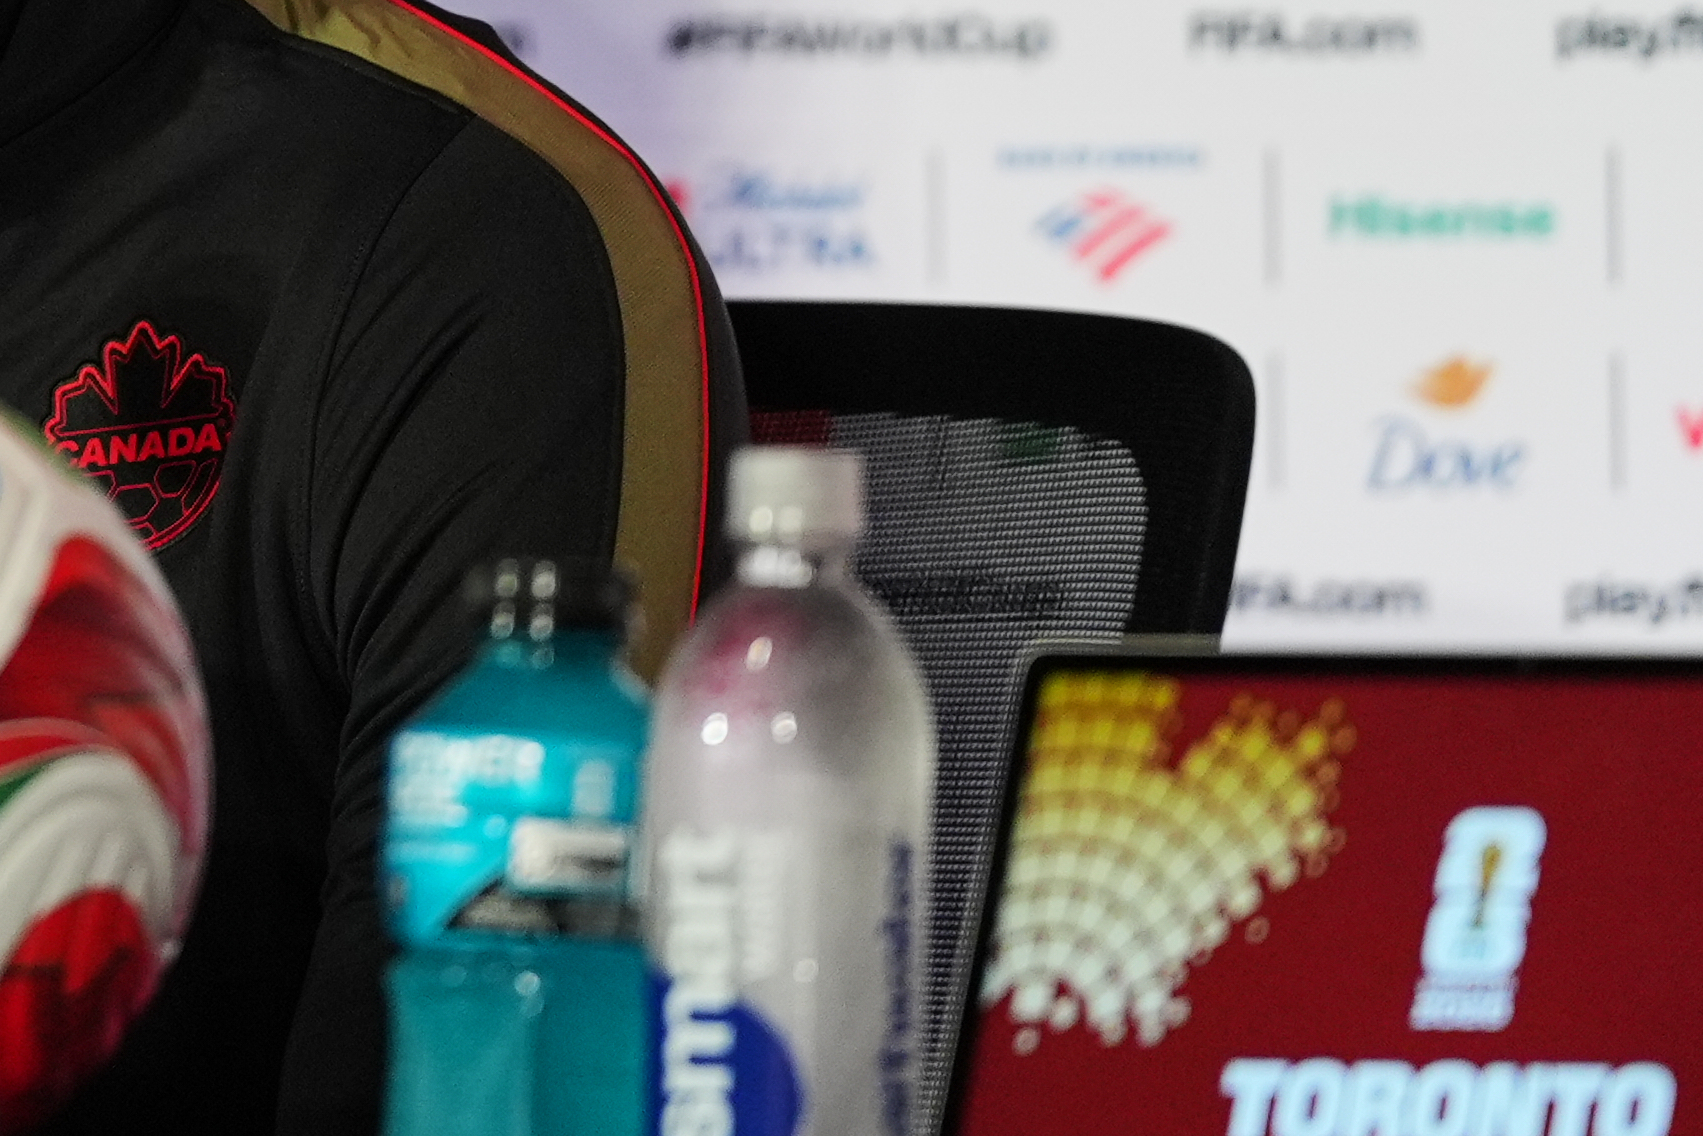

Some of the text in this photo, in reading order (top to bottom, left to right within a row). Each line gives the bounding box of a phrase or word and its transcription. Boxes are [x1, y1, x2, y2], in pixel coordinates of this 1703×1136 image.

[1327, 194, 1557, 240] Hisense
[54, 422, 222, 470] CANADA
[1367, 414, 1525, 492] Dove
[660, 826, 736, 1136] smart
[1219, 1058, 1677, 1136] TORONTO
